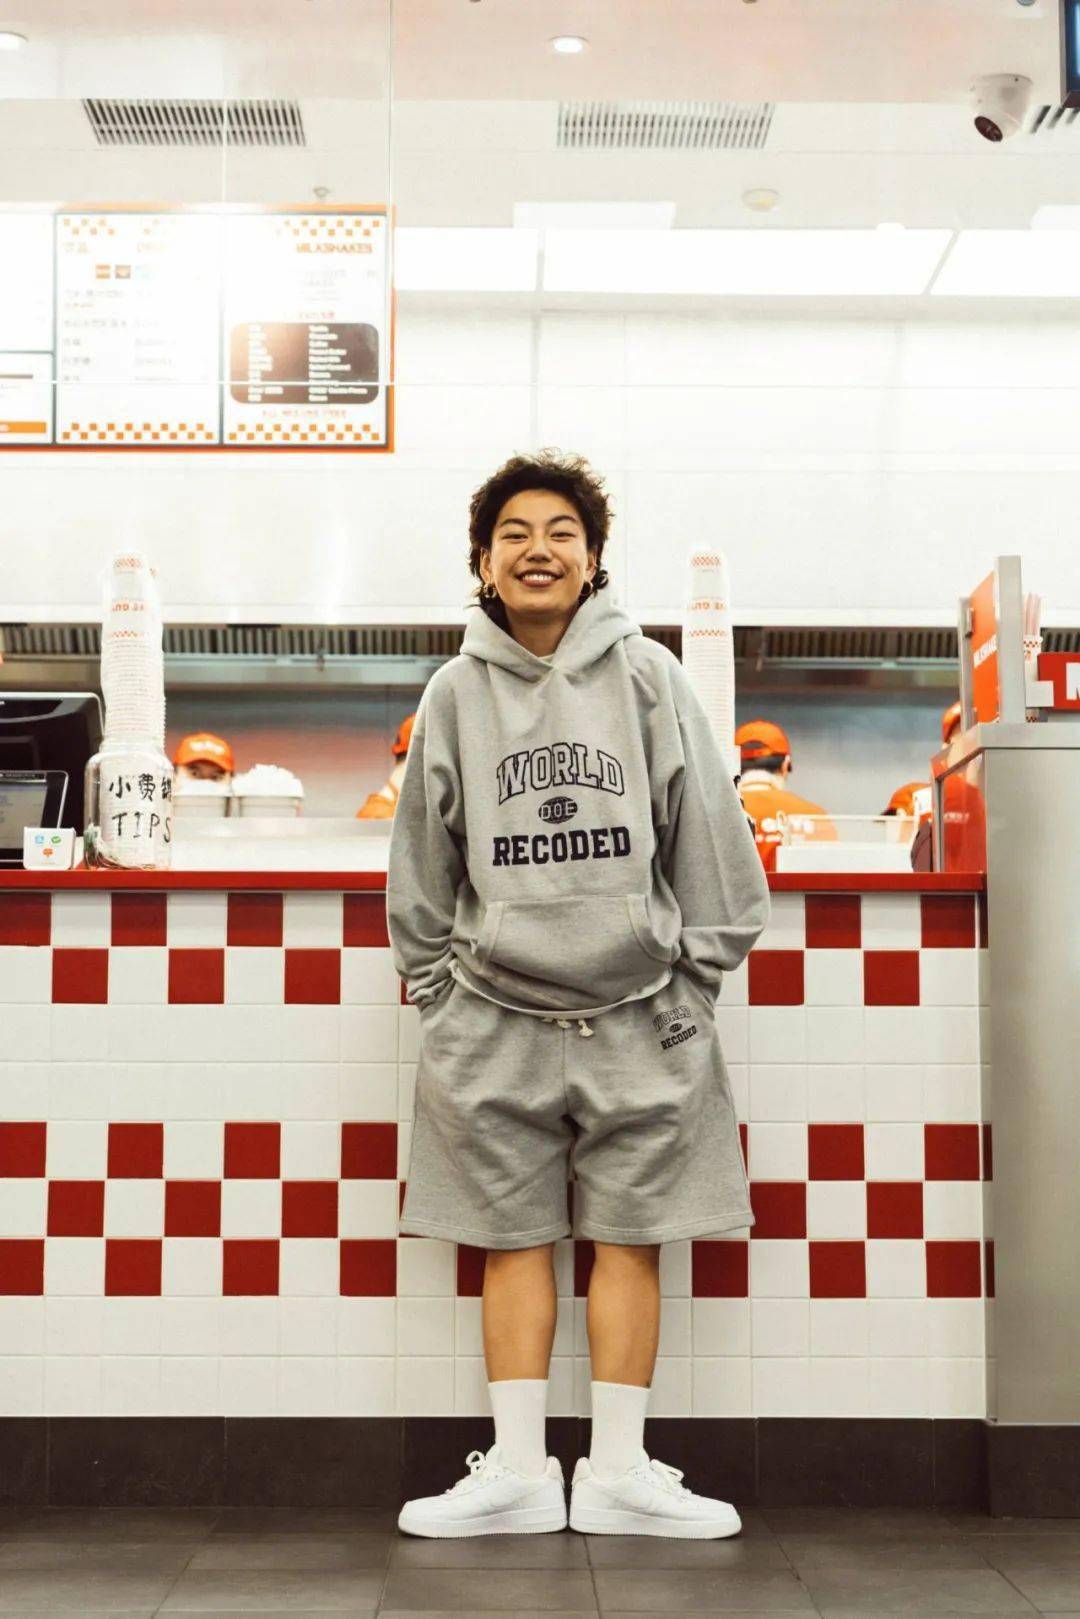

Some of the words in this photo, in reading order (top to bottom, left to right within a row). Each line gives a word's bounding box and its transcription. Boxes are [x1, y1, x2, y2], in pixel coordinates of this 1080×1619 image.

[496, 742, 625, 805] WORLD
[540, 799, 576, 820] DOE
[112, 811, 171, 843] TIPS
[492, 826, 632, 867] RECODED
[660, 1025, 697, 1050] RECODED
